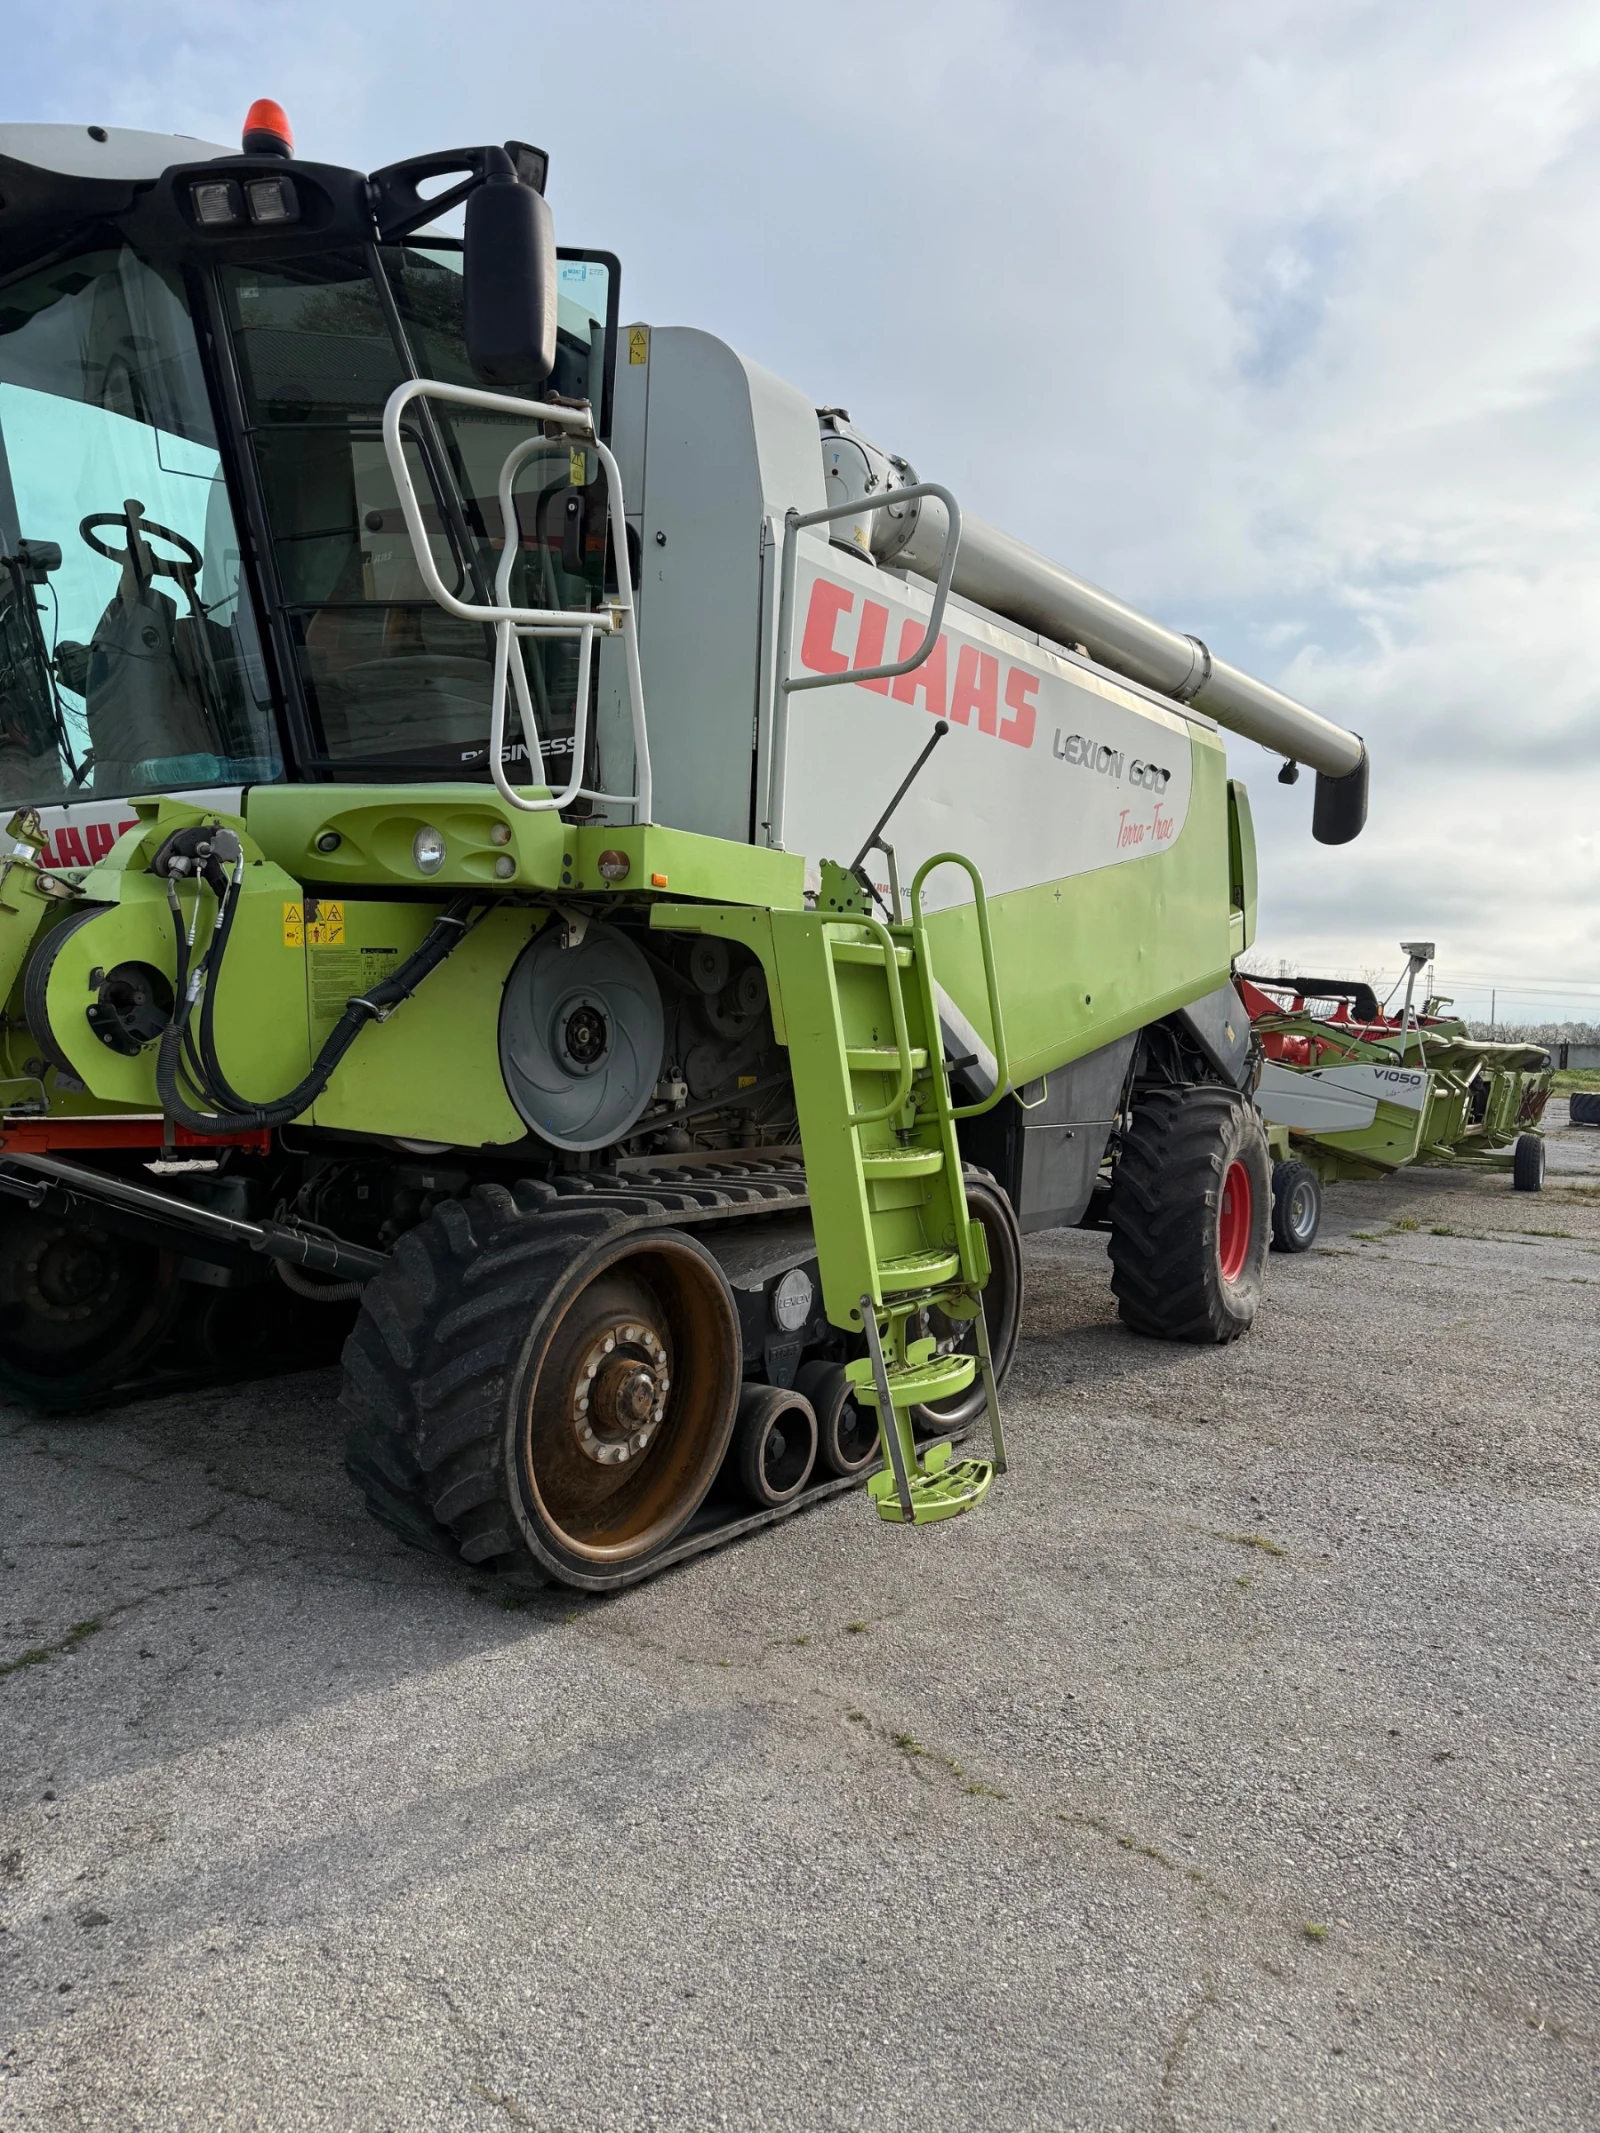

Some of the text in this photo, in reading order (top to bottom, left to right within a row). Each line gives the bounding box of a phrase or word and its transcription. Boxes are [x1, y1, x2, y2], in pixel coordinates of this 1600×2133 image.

[801, 578, 1040, 749] CLAAS
[1053, 728, 1171, 795] LEXION 600
[1117, 803, 1174, 848] Terra-Trac
